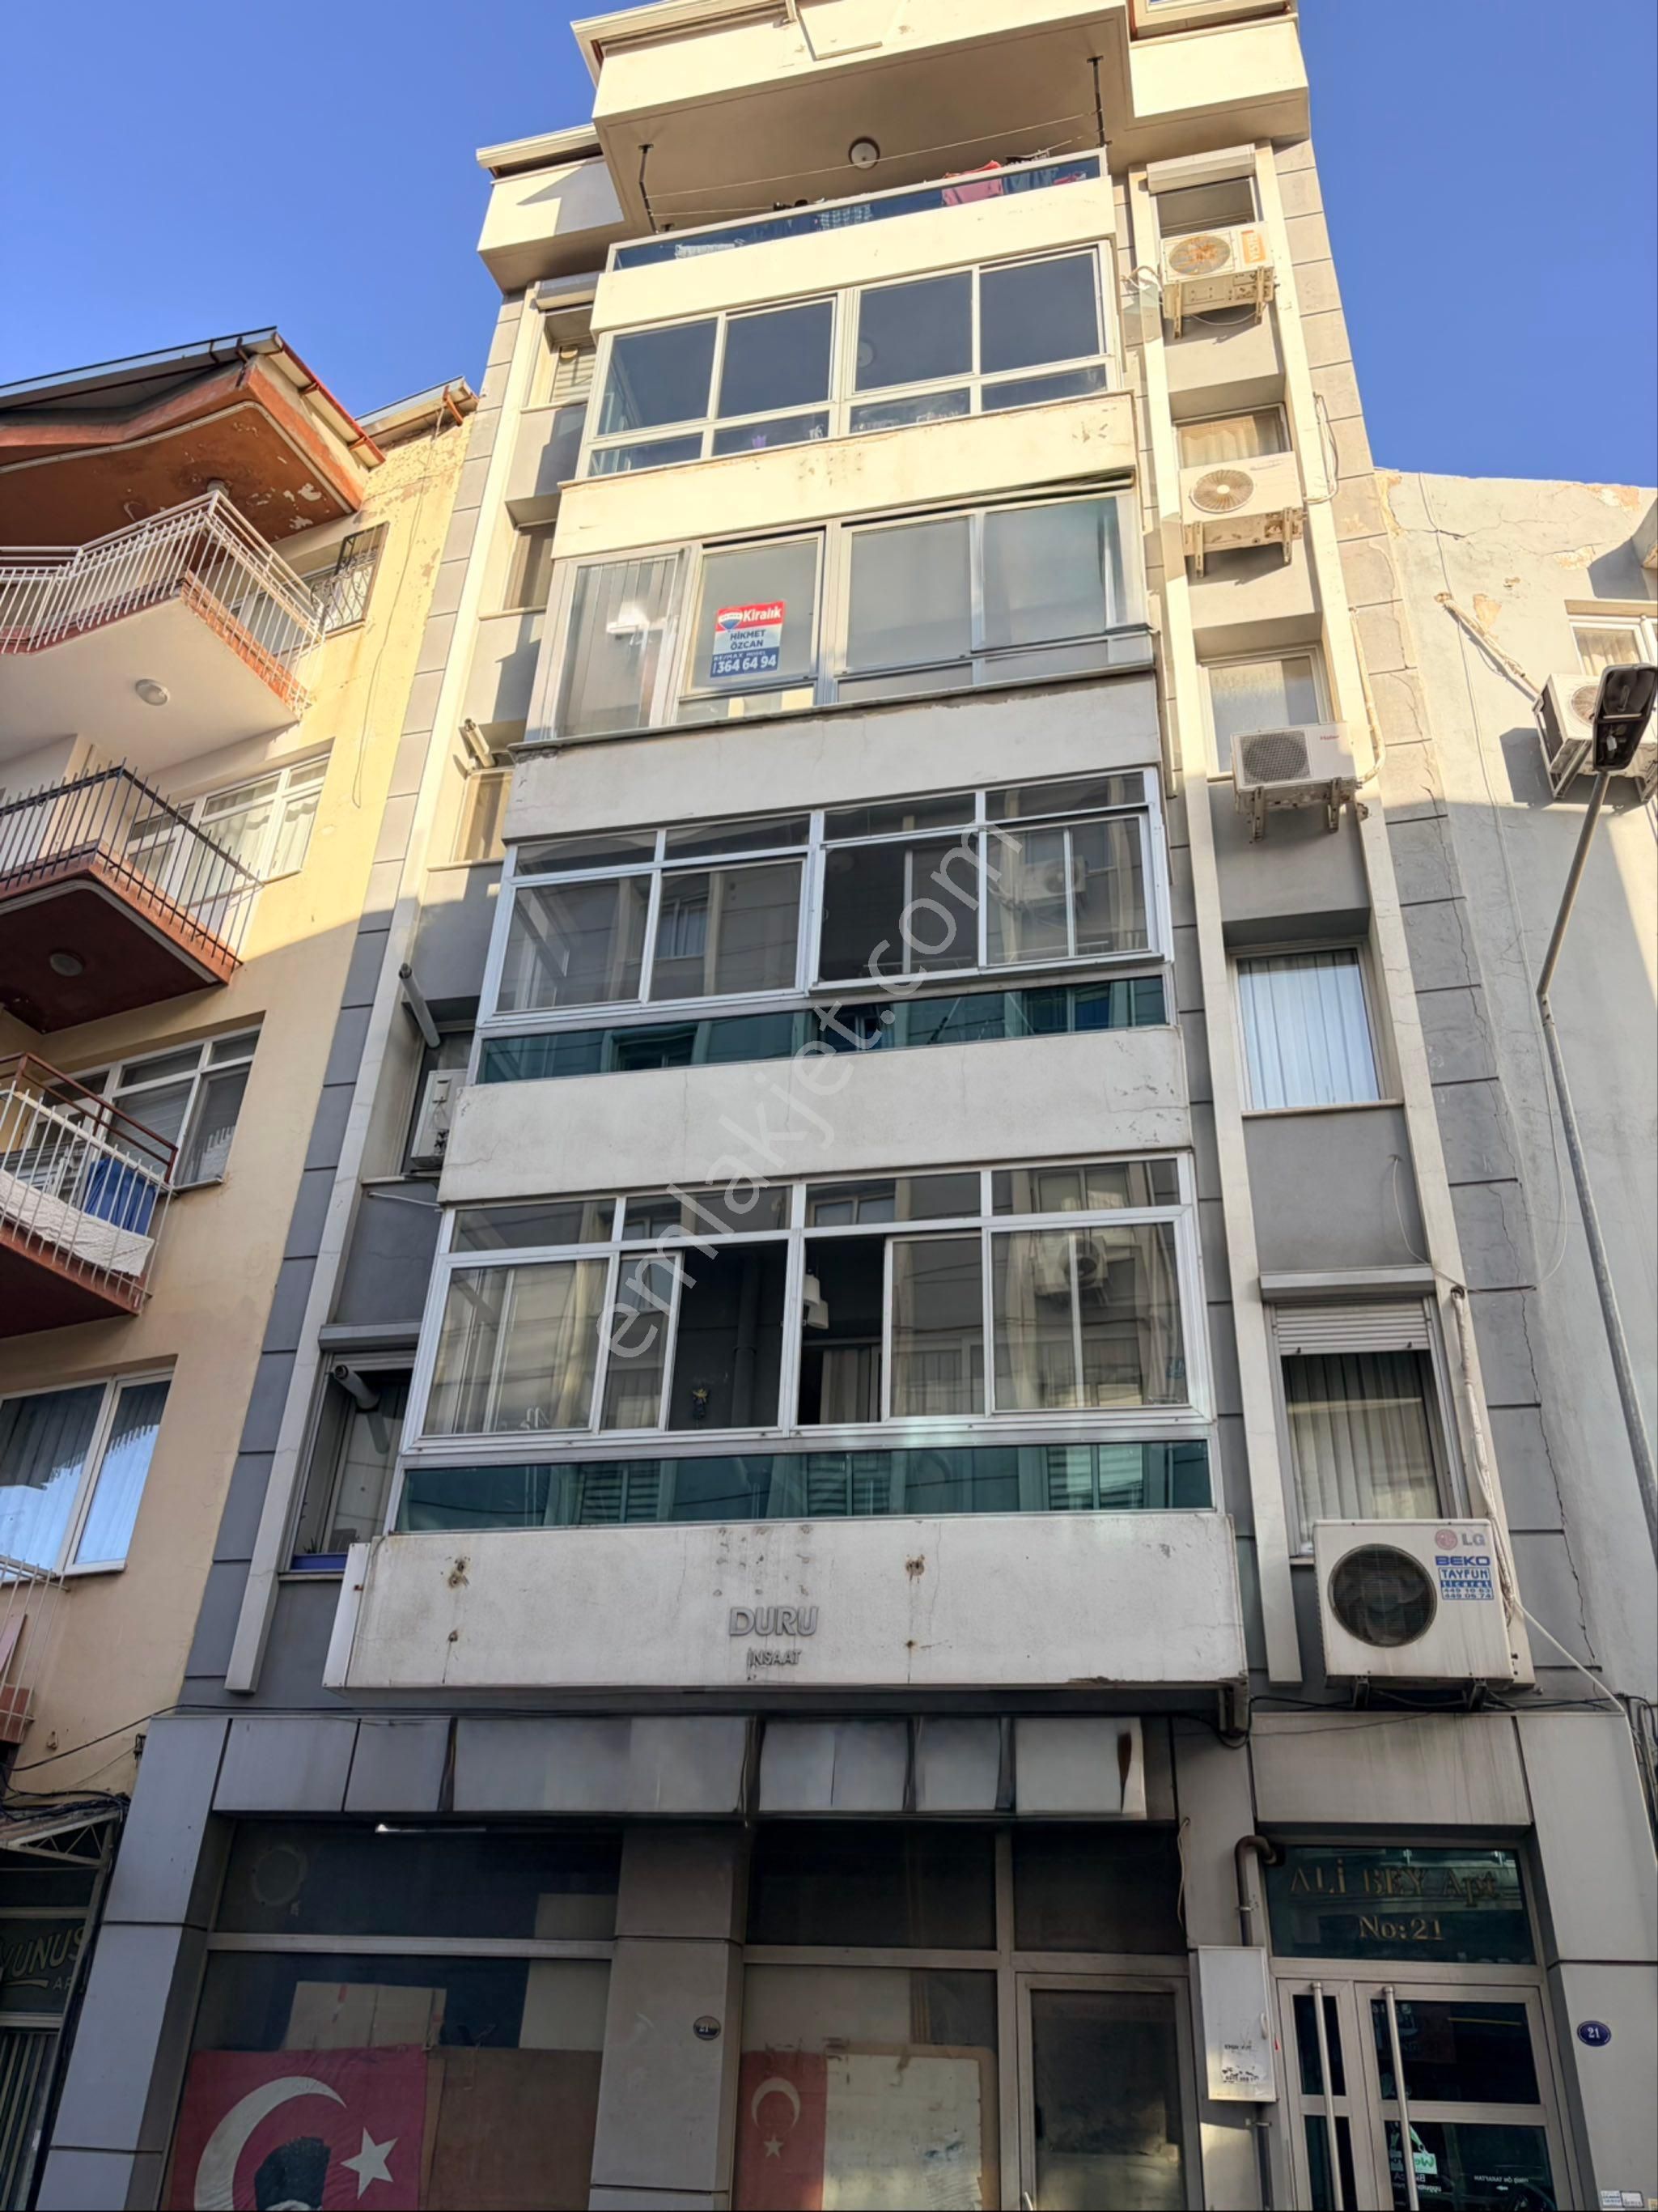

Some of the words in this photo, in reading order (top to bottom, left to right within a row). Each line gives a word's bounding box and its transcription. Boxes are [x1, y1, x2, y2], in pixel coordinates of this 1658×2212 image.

[743, 605, 782, 622] Kiralık
[730, 629, 766, 641] HİKMET
[730, 639, 764, 651] ÖZCAN
[718, 657, 740, 674] 364
[742, 656, 758, 670] 64
[761, 655, 777, 668] 94
[1461, 1532, 1486, 1547] LG
[1435, 1556, 1491, 1566] BEKO
[1441, 1569, 1489, 1579] TAYFUN
[729, 1606, 819, 1637] DURU
[1290, 1857, 1346, 1894] ALİ
[1363, 1866, 1426, 1896] BEY
[1587, 2027, 1601, 2039] 21
